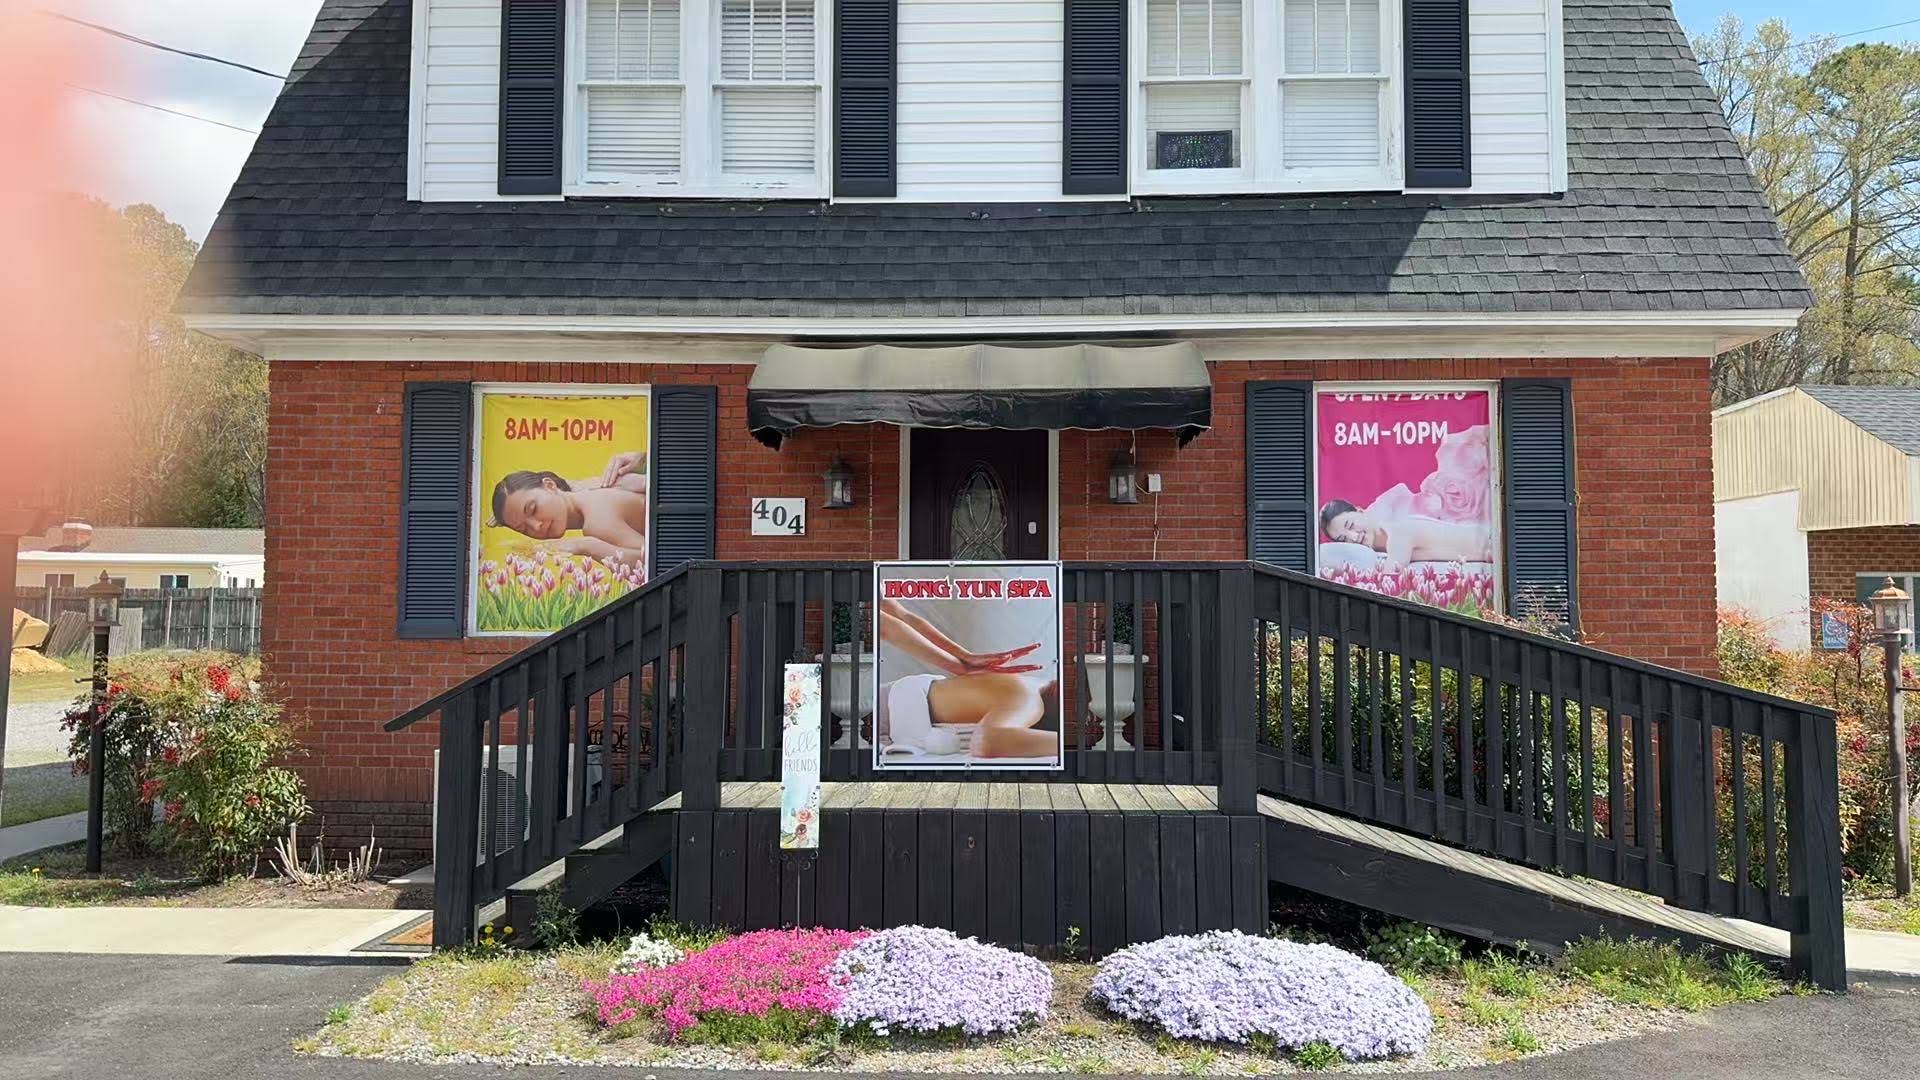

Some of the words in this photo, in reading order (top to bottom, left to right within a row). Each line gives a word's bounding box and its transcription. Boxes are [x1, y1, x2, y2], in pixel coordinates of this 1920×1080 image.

[504, 417, 613, 441] 8AM-10PM
[1334, 421, 1448, 445] 8AM-10PM
[753, 499, 804, 535] 404
[884, 579, 951, 598] HONG
[955, 580, 1002, 598] YUN
[1007, 579, 1052, 598] SPA
[784, 758, 818, 772] FRIENDS
